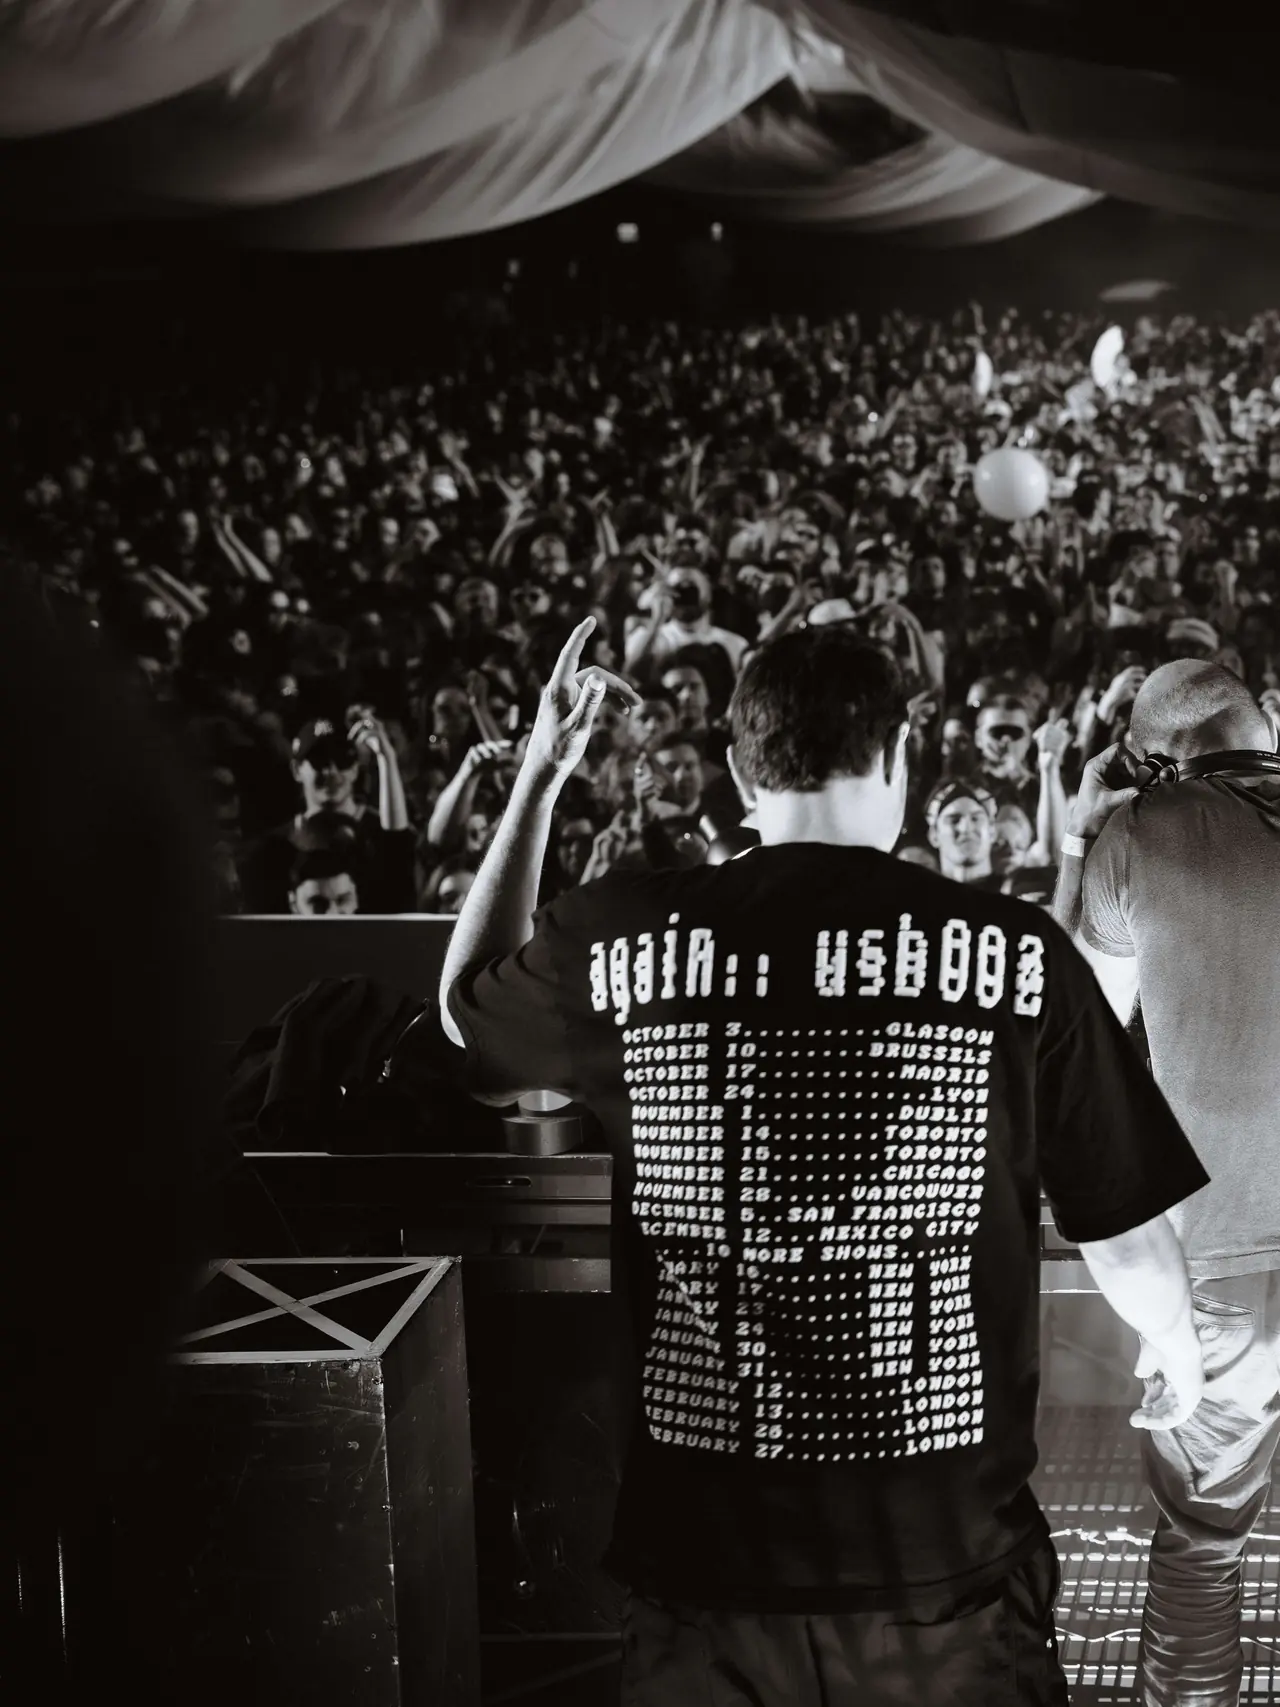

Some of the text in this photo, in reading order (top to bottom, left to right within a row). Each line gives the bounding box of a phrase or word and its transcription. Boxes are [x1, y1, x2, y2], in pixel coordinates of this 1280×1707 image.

[622, 1022, 994, 1046] OCTOBER 3 GLASGOW
[624, 1043, 992, 1065] OCTOBER 10 BRUSSELS
[624, 1064, 989, 1084] OCTOBER 17 MADRID
[629, 1085, 989, 1104] OCTOBER 24 LYON
[632, 1105, 988, 1123] NOVEMBER 1 DUBLIN
[632, 1124, 987, 1143] NOVEMBER 14 TORONTO
[634, 1143, 986, 1162] NOVEMBER 15 TORONTO
[636, 1162, 985, 1181] NOVEMBER 21 CHICAGO
[633, 1182, 984, 1202] NOVEMBER 28 VANCOUVER
[632, 1201, 981, 1222] DECEMBER 5 SAN FRANCISCO
[641, 1220, 979, 1242] ECEMBER 12 MEXICO CITY
[743, 1247, 804, 1263] MORE
[821, 1244, 898, 1261] SHOWS
[868, 1263, 914, 1279] NEW
[929, 1255, 972, 1275] YORK
[739, 1283, 762, 1294] 17
[868, 1282, 914, 1298] NEW
[930, 1274, 970, 1295] YORK
[736, 1303, 762, 1314] 23
[869, 1301, 913, 1318] NEW
[930, 1293, 971, 1314] YORK
[736, 1322, 763, 1335] 24
[870, 1320, 913, 1337] NEW
[930, 1312, 974, 1333] YORK
[737, 1341, 766, 1356] 30
[871, 1339, 912, 1358] NEW
[929, 1331, 977, 1353] YORK
[645, 1345, 980, 1378] JANUARY 31 NEW YORK
[643, 1364, 983, 1398] FEBRUARY 12 LONDON
[643, 1384, 984, 1419] FEBRUARY 13 LONDON
[903, 1408, 984, 1436] LONDON
[755, 1444, 783, 1458] 27
[904, 1427, 983, 1456] LONDON
